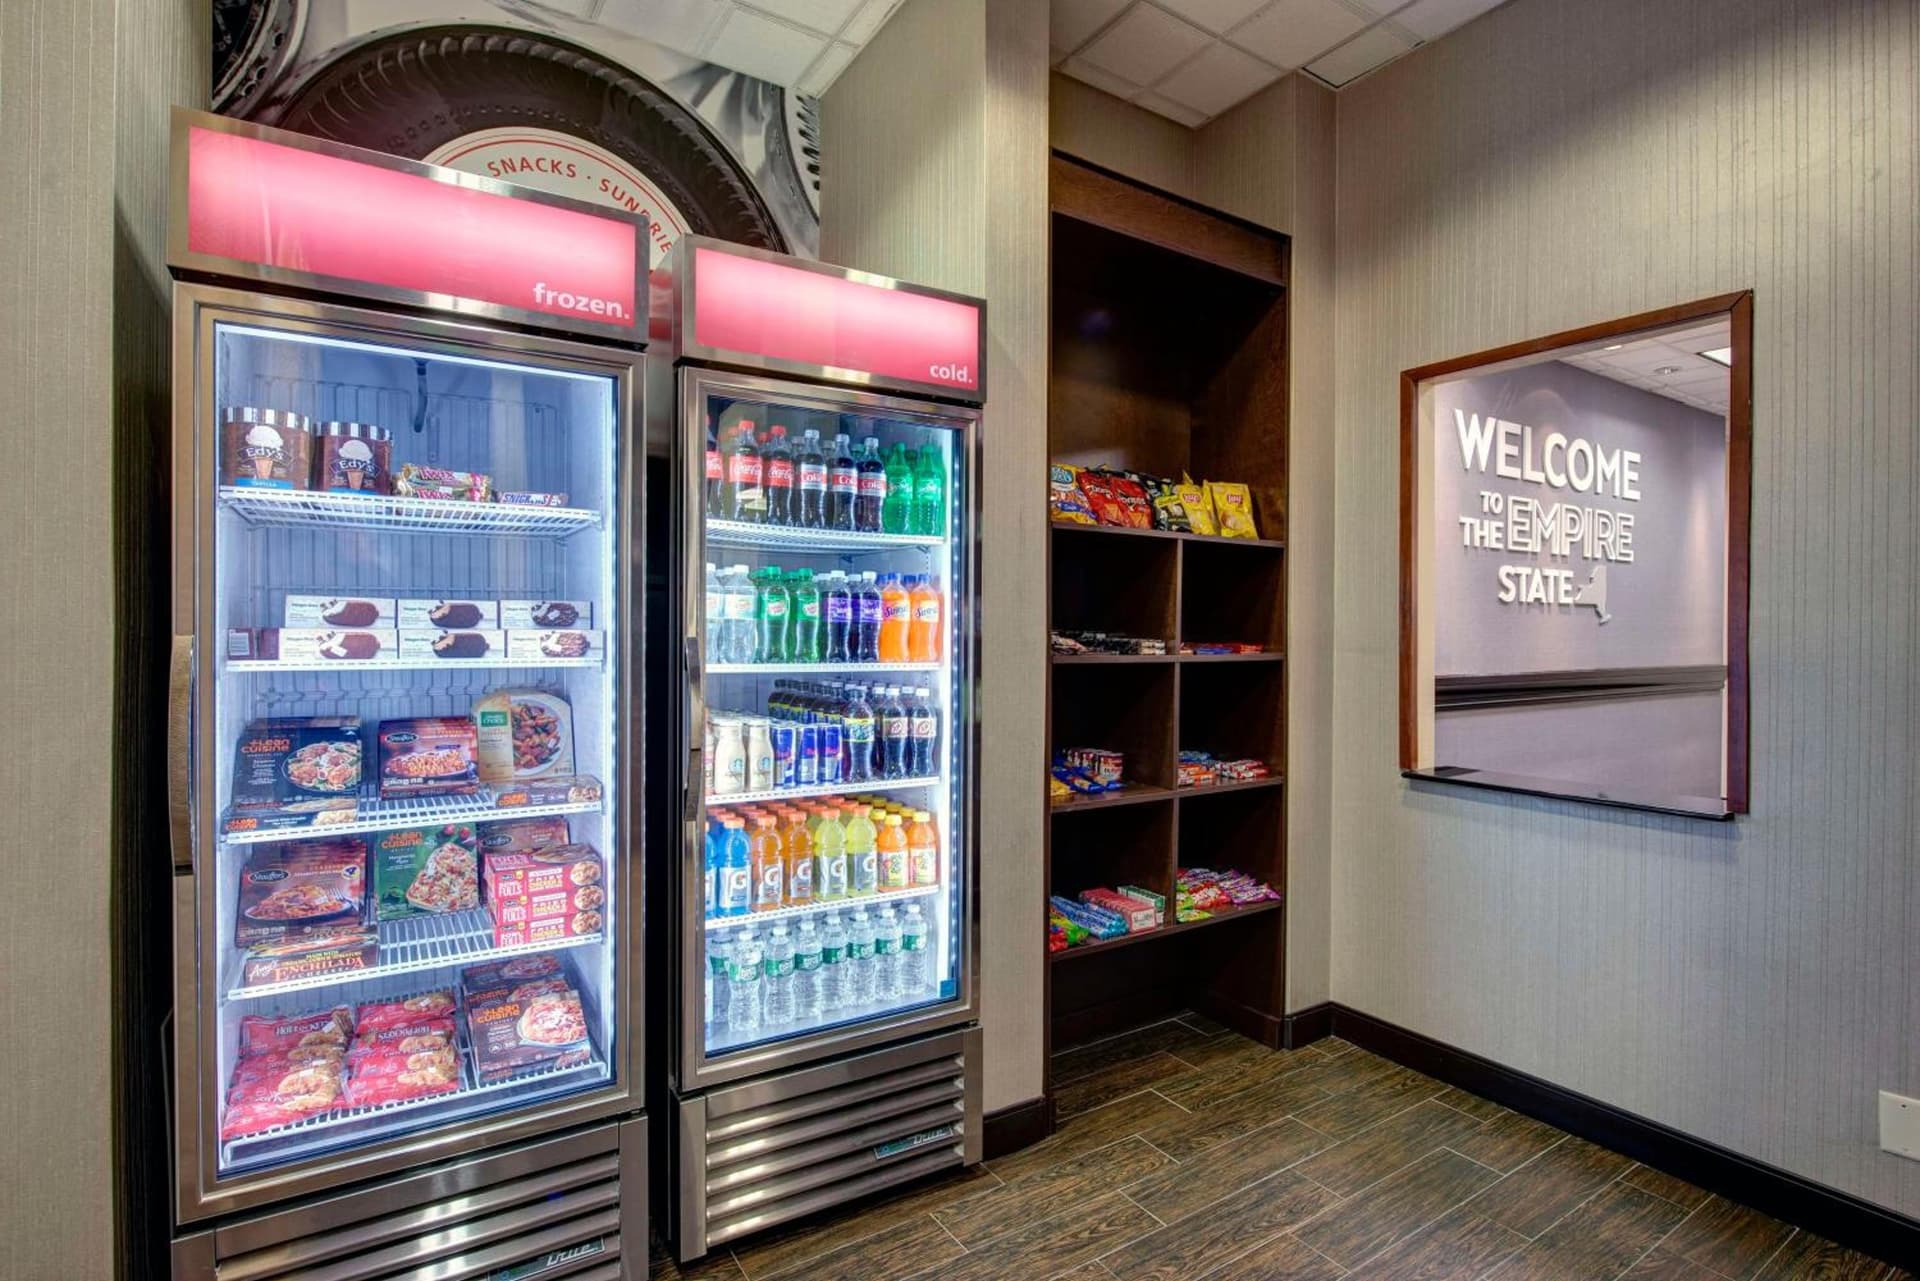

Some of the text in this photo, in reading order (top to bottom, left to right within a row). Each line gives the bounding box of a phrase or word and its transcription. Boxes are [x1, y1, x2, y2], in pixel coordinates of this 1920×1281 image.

[487, 156, 673, 253] SNACKS SUNRIE
[533, 282, 630, 320] frozen.
[930, 363, 972, 383] cold.
[246, 446, 285, 460] Edy's
[339, 460, 377, 473] Edy's
[1455, 408, 1641, 501] WELCOME
[1480, 491, 1503, 514] TO
[1459, 495, 1634, 562] THE EMPIRE
[1498, 564, 1574, 604] STATE
[274, 956, 365, 982] ENCHILADA
